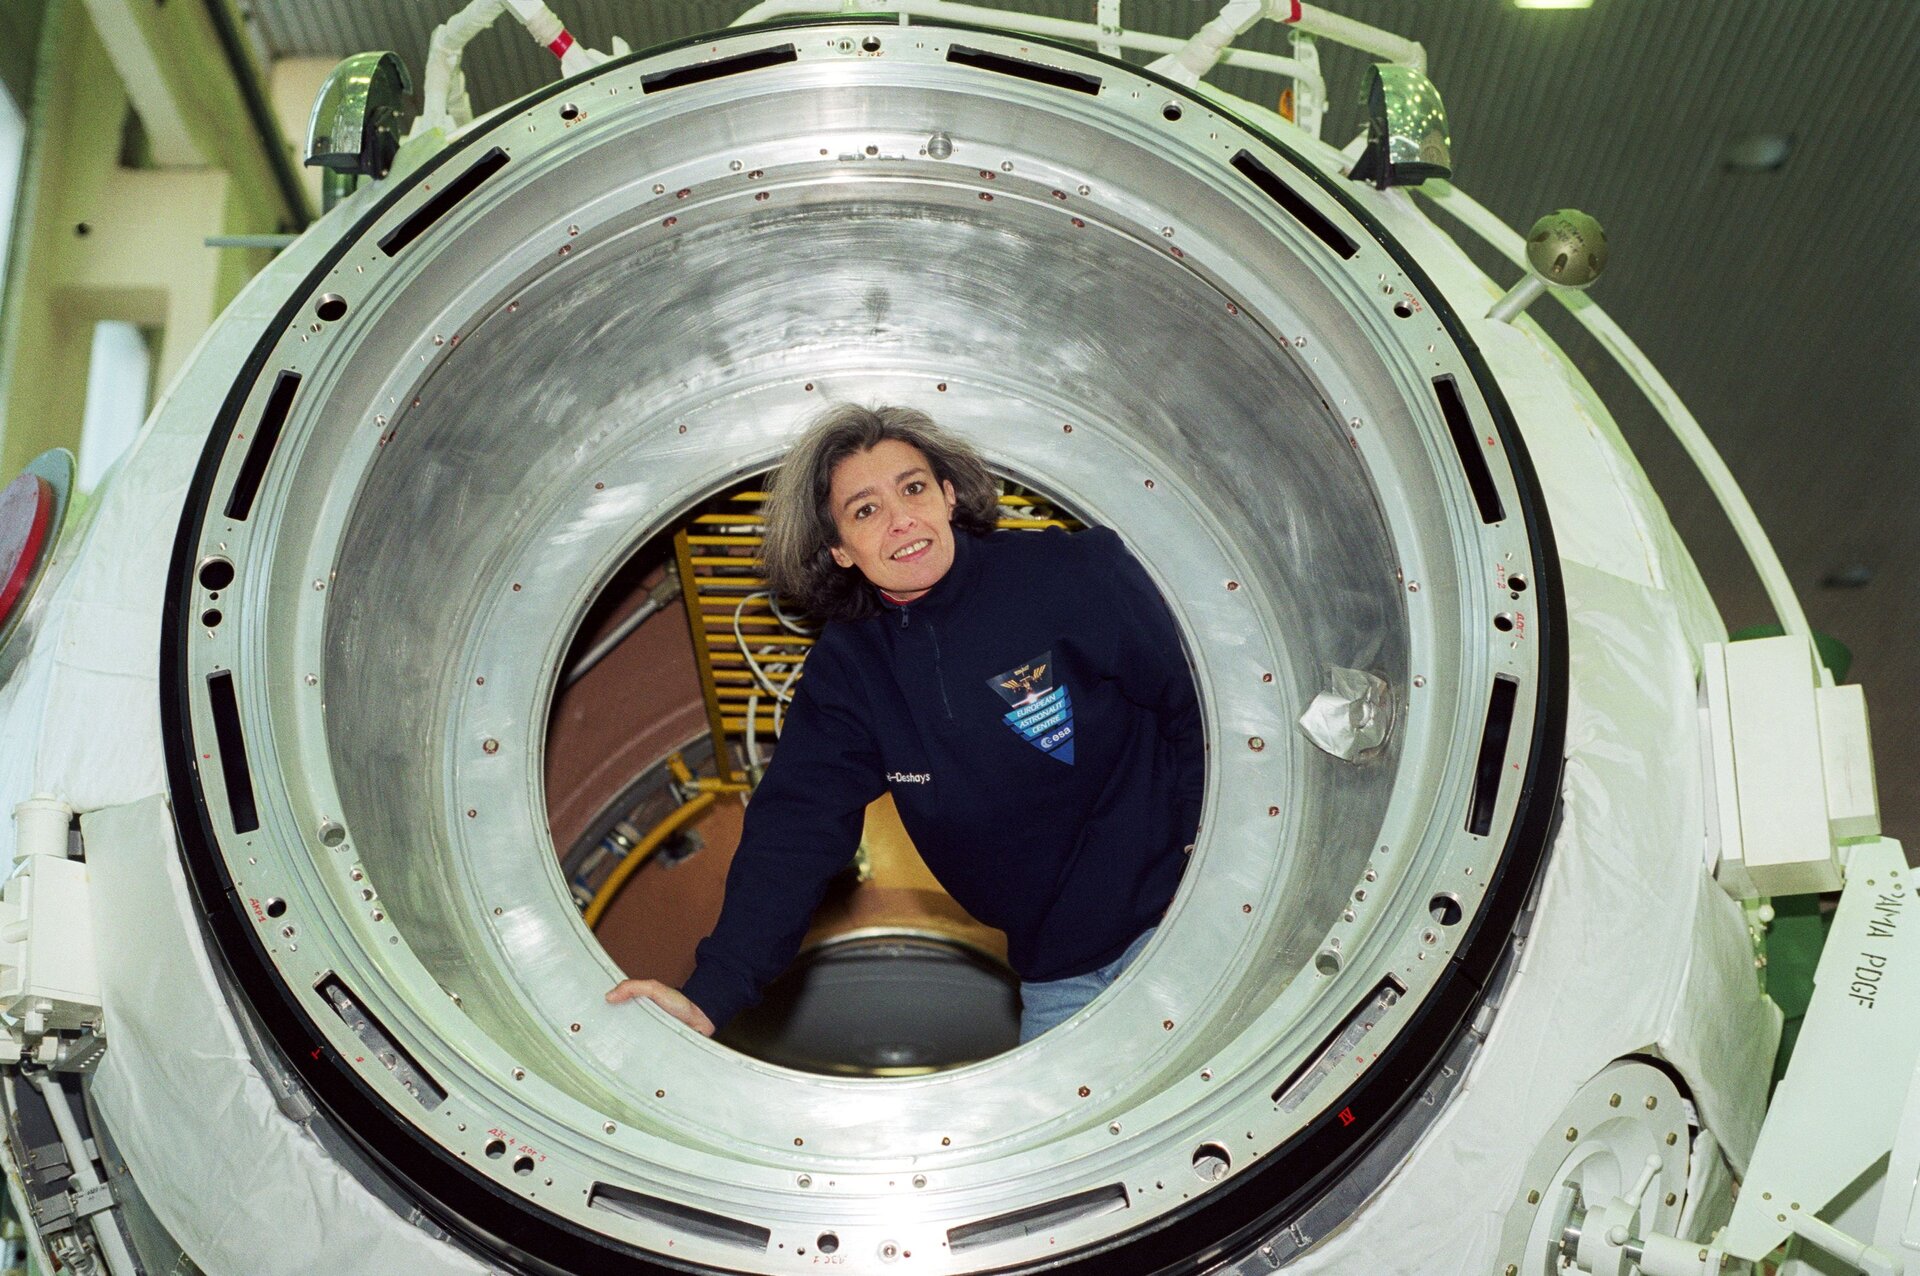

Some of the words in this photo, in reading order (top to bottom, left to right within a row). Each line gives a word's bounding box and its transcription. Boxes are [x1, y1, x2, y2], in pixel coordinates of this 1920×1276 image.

[1016, 693, 1057, 718] EUROPEAN
[1019, 701, 1064, 728] ASTRONAUT
[1032, 714, 1061, 734] CENTRE
[1052, 726, 1072, 742] esa
[1848, 952, 1887, 1009] PDGF
[1337, 1106, 1356, 1127] IV
